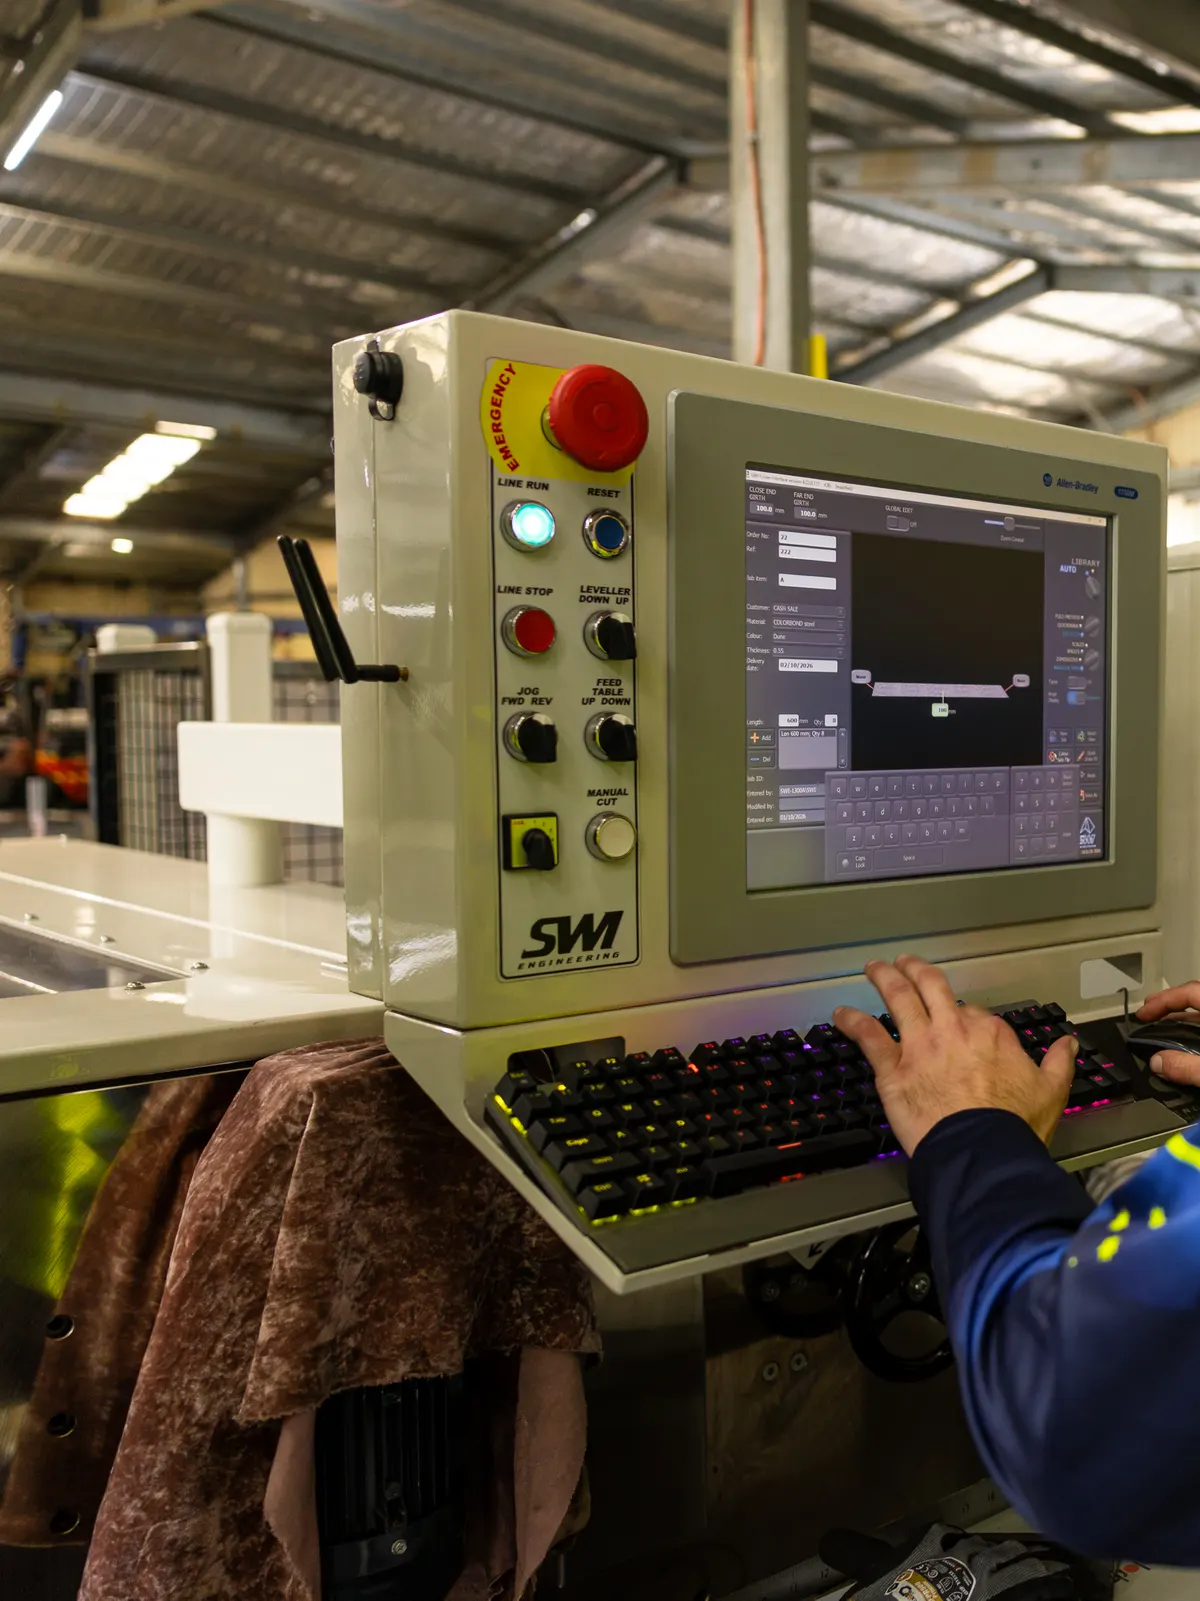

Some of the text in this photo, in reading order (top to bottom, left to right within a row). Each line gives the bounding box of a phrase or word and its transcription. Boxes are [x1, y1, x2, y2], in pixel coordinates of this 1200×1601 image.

[490, 363, 520, 472] EMERGENCY
[497, 478, 550, 491] LINE RUN
[1057, 478, 1099, 494] Allen-Bradley
[587, 488, 620, 498] RESET
[749, 486, 777, 496] CLOSE END
[793, 491, 814, 500] FAR END
[749, 493, 766, 501] GIRTH
[756, 504, 773, 513] 100.0
[885, 505, 903, 513] GLOBAL
[800, 510, 816, 518] 100.0
[1071, 558, 1100, 567] LIBRARY
[1059, 564, 1077, 573] AUTO
[497, 585, 553, 596] LINE STOP
[580, 585, 631, 596] LEVELLER
[579, 595, 629, 605] DOWN UP
[746, 603, 770, 611] Customer:
[773, 604, 786, 612] CASH
[773, 619, 803, 627] COLORBOND
[596, 678, 622, 687] FEED
[517, 687, 539, 696] JOG
[592, 688, 624, 696] TABLE
[501, 697, 553, 706] FWD REV
[581, 697, 631, 706] UP DOWN
[811, 731, 820, 739] Qty
[587, 788, 629, 797] MANUAL
[596, 798, 618, 806] CUT
[517, 951, 620, 971] ENGINEERING
